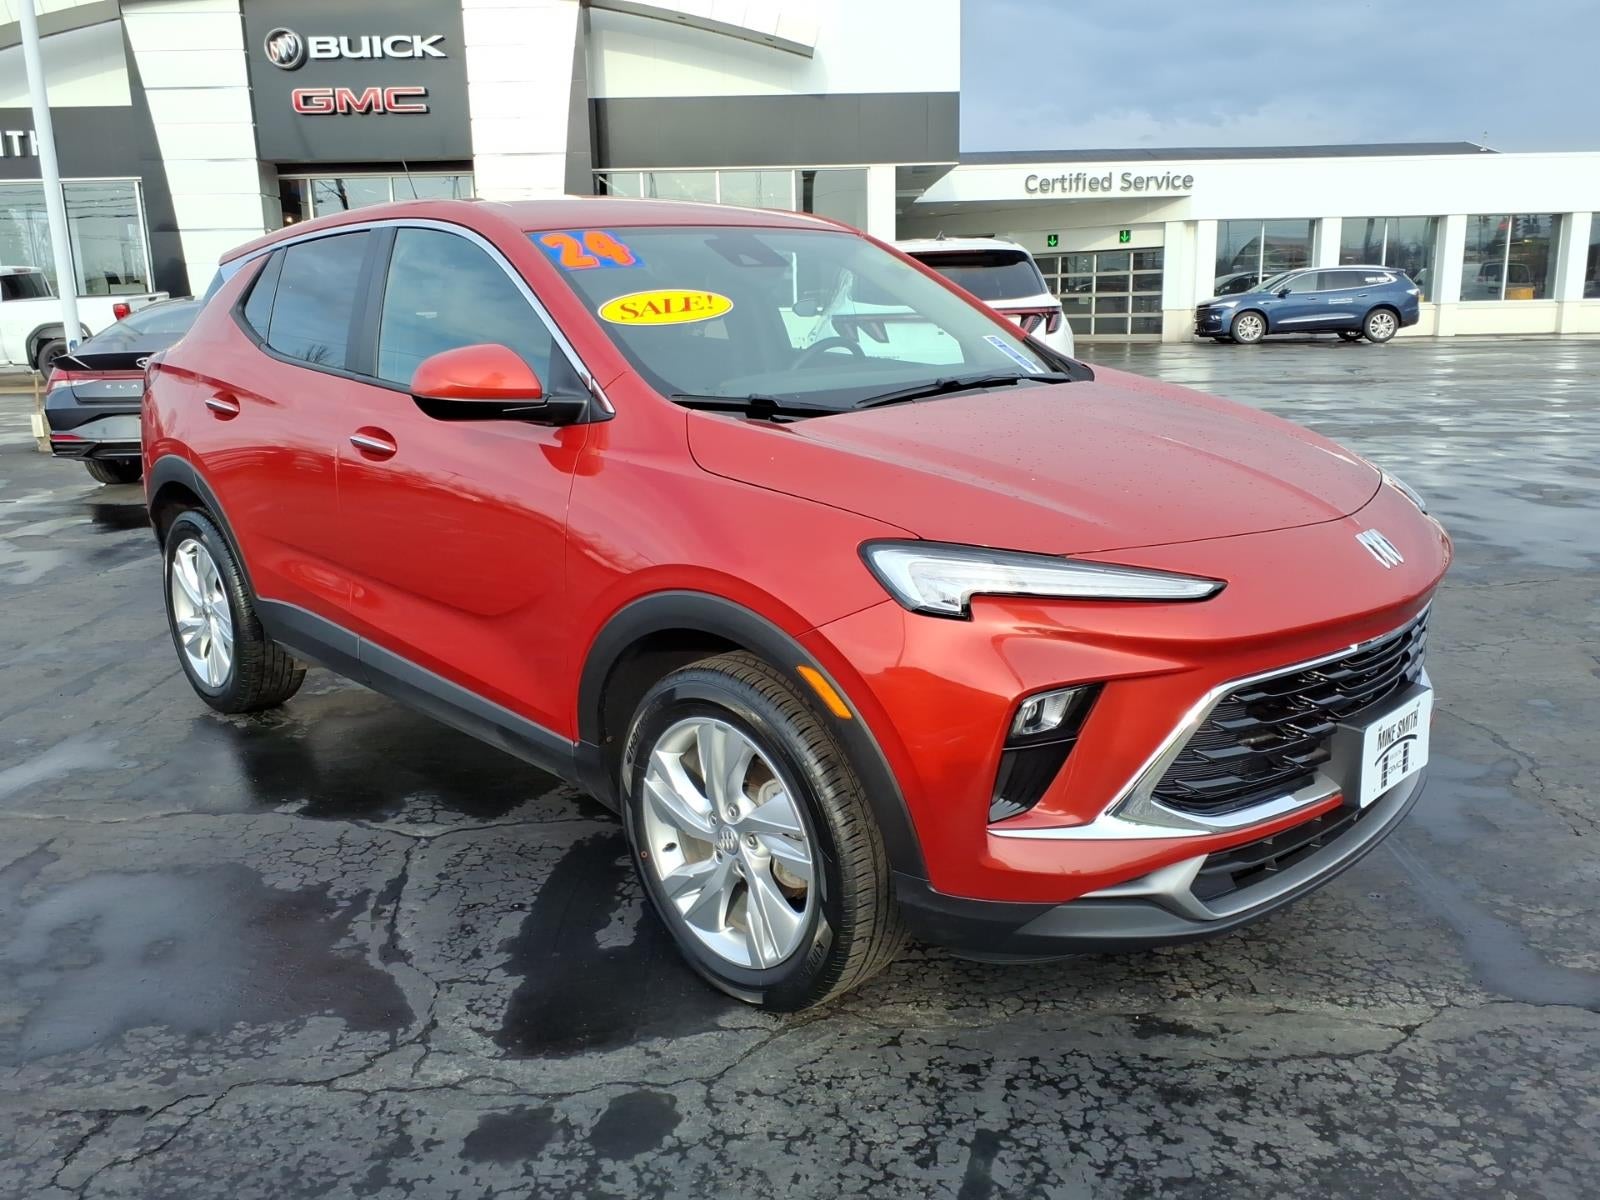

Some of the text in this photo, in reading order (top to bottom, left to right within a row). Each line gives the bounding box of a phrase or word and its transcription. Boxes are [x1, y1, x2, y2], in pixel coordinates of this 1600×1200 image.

[308, 35, 446, 58] BUICK
[291, 86, 428, 114] GMC
[1024, 171, 1194, 194] Certified Service
[540, 230, 635, 269] 24
[619, 294, 714, 321] SALE!
[1397, 709, 1418, 738] SMITH
